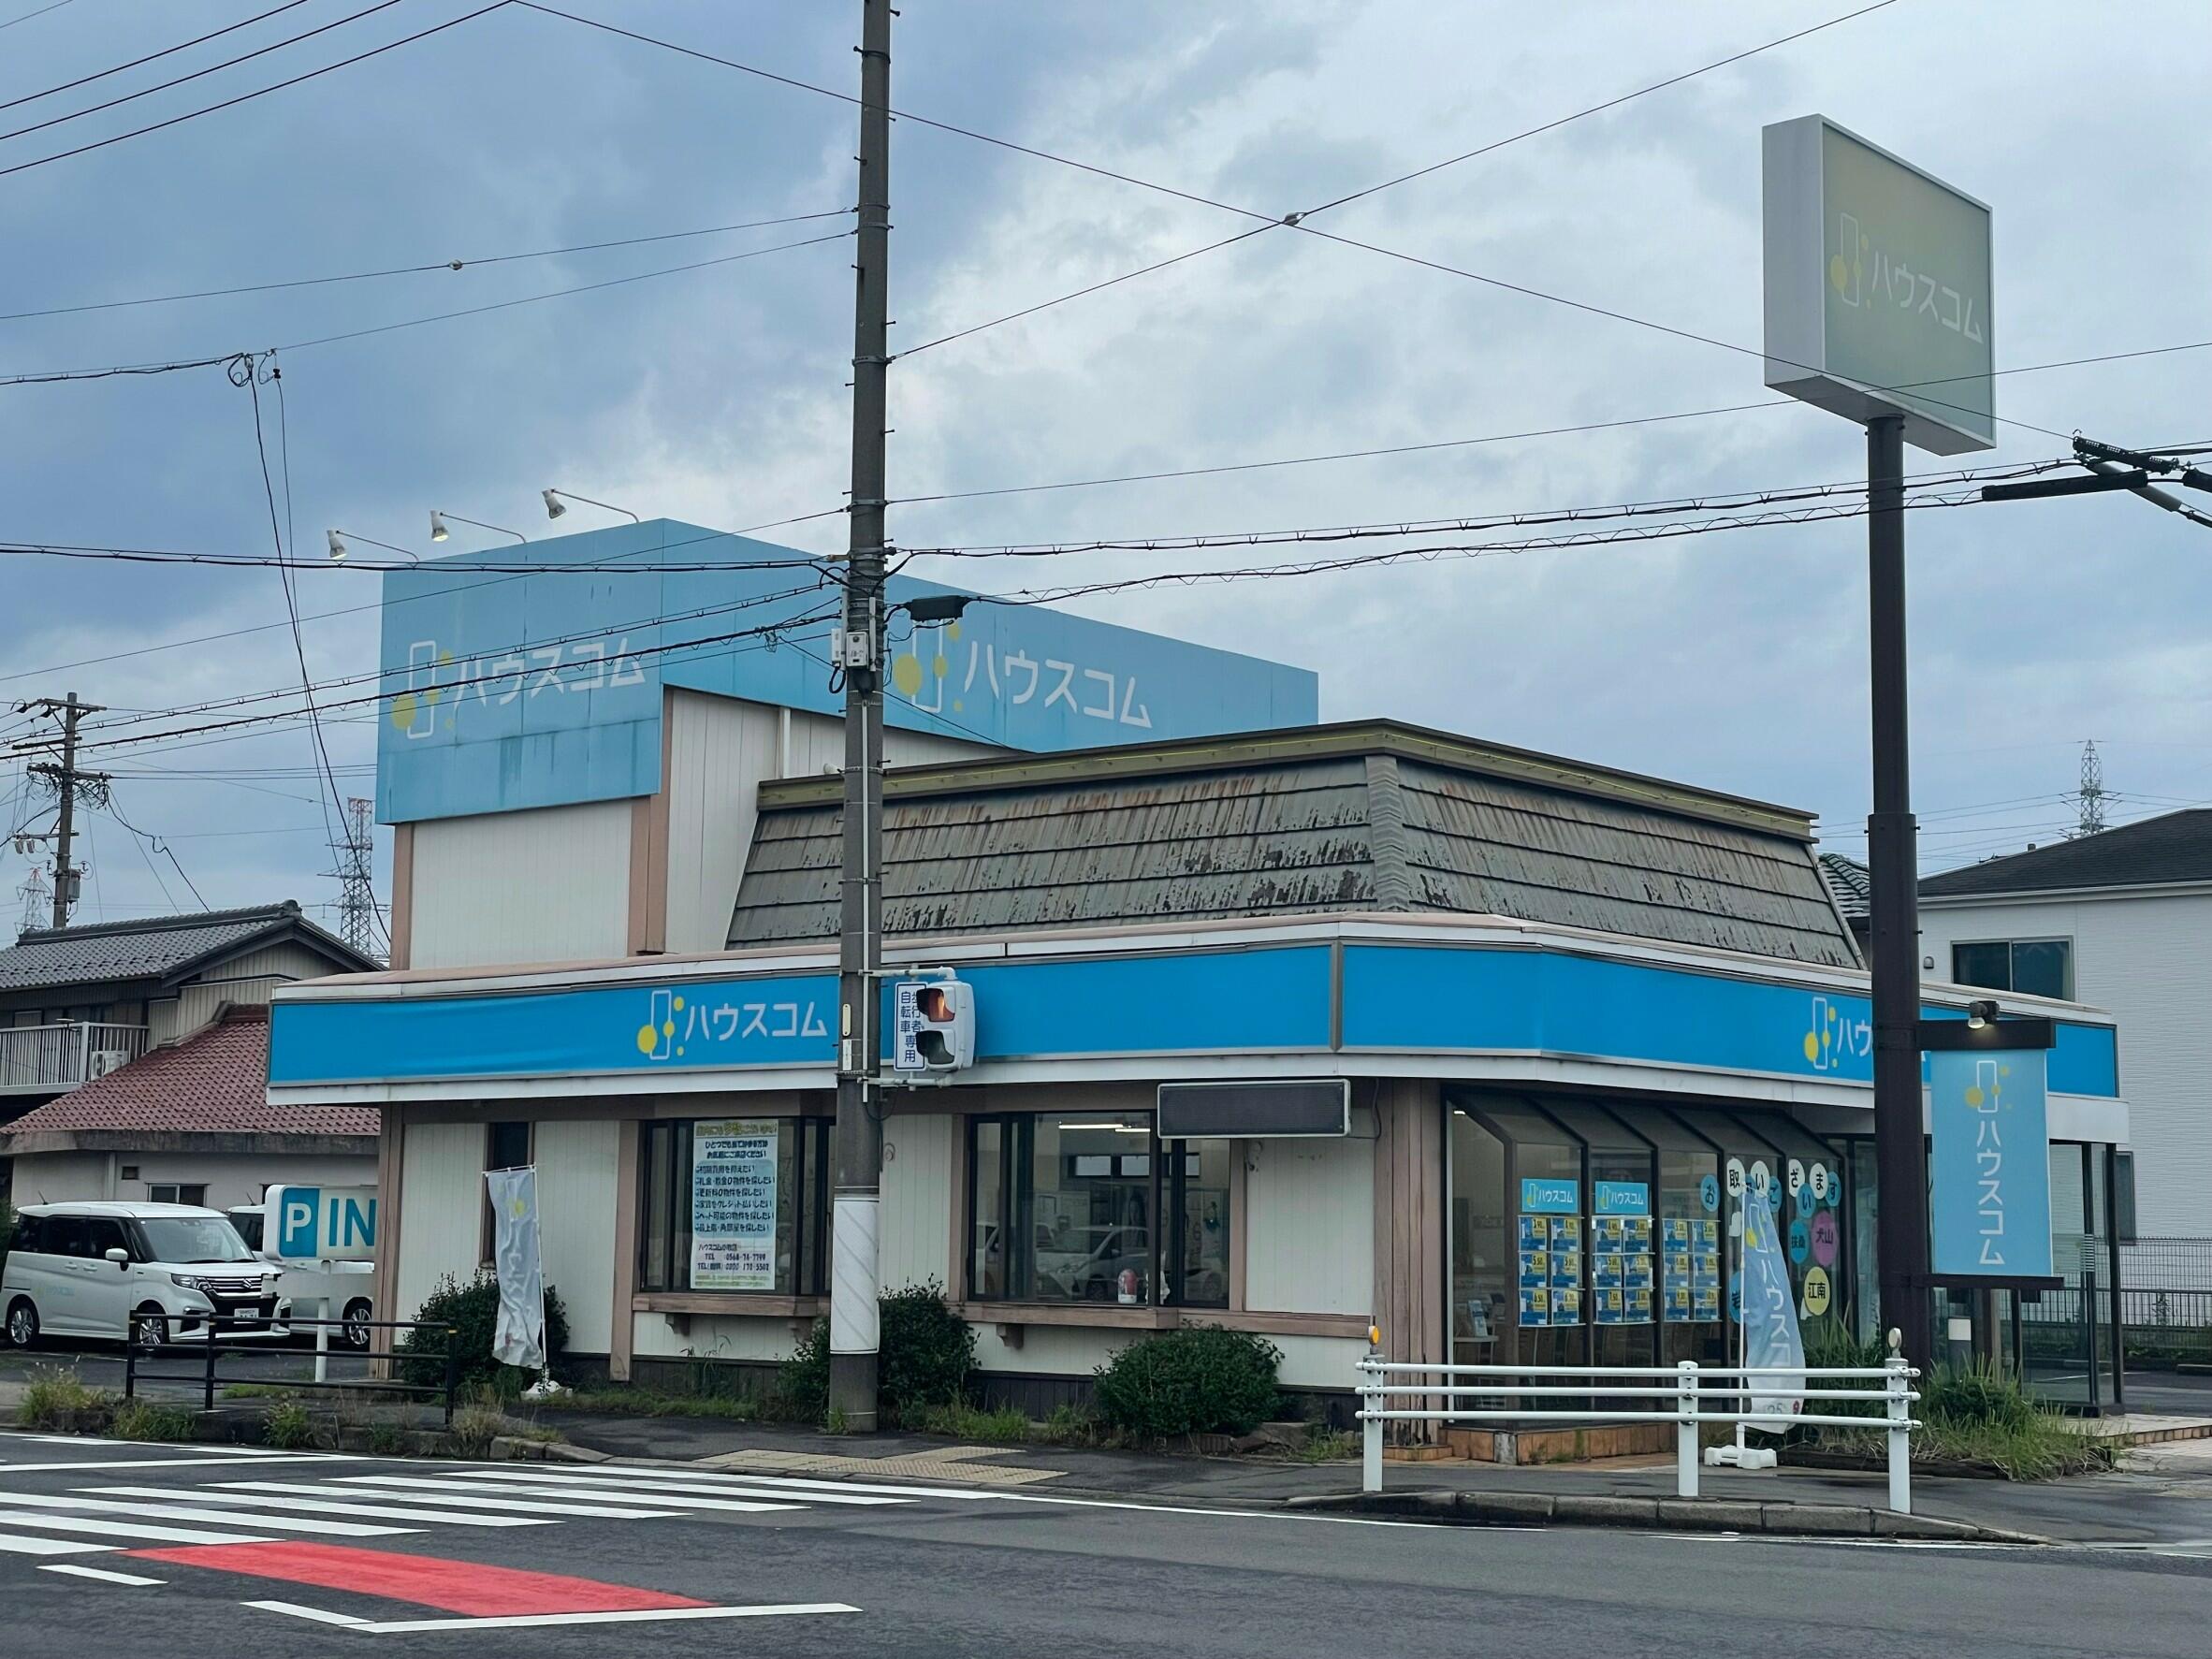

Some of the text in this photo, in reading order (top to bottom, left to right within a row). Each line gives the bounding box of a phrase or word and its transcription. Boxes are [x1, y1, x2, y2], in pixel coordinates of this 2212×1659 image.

[1871, 251, 1984, 344] ハウスコム
[454, 637, 646, 708] ハウスコム
[964, 641, 1153, 729] ハウスコム
[685, 1001, 828, 1041] ハウスコム
[900, 992, 911, 1033] 自転車
[905, 1035, 917, 1063] 専用
[1538, 1189, 1573, 1203] ハウスコム
[1610, 1191, 1645, 1205] ハウスコム
[1976, 1120, 2006, 1266] ハウスコム
[285, 1202, 313, 1243] P
[1815, 1228, 1834, 1245] 犬山
[1808, 1282, 1826, 1300] 江南
[1760, 1259, 1792, 1367] ハウスコ
